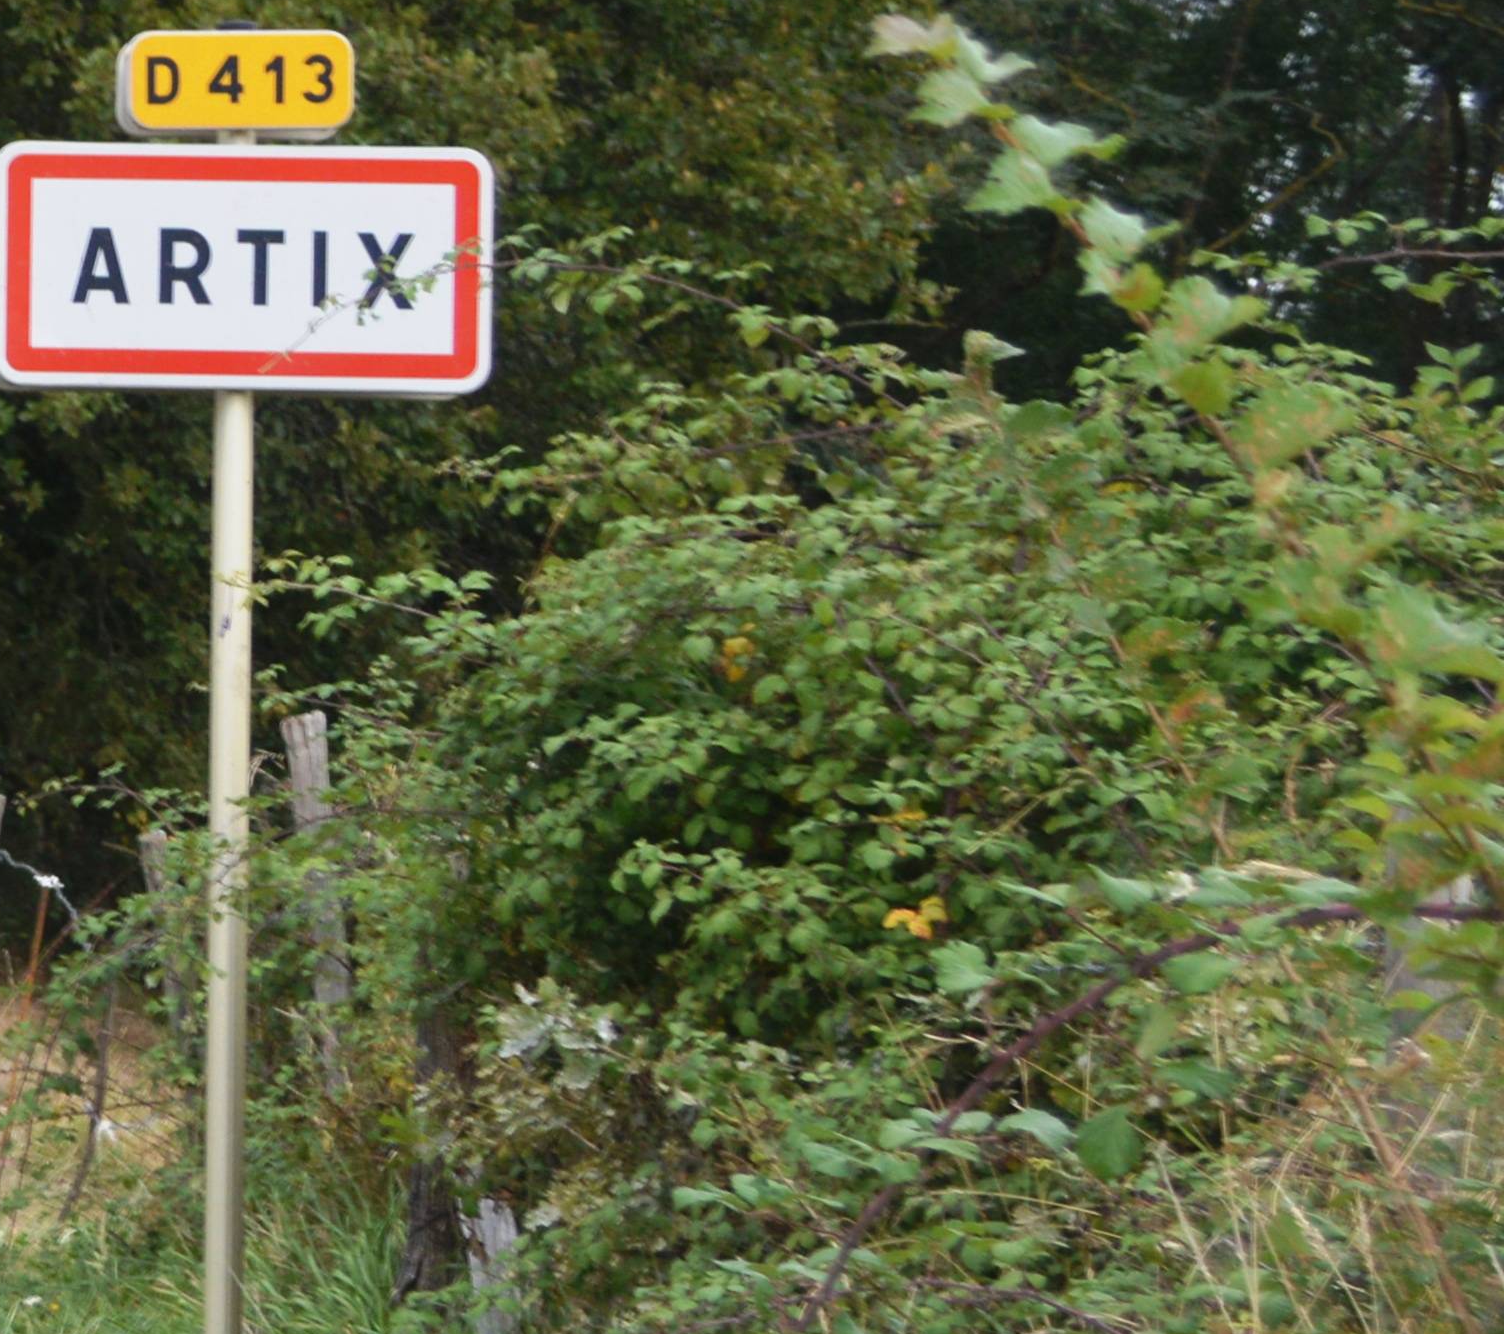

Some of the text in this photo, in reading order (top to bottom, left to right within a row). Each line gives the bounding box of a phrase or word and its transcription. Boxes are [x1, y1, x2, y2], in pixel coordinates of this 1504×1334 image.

[145, 53, 335, 105] D 413
[71, 226, 416, 312] ARTIX
